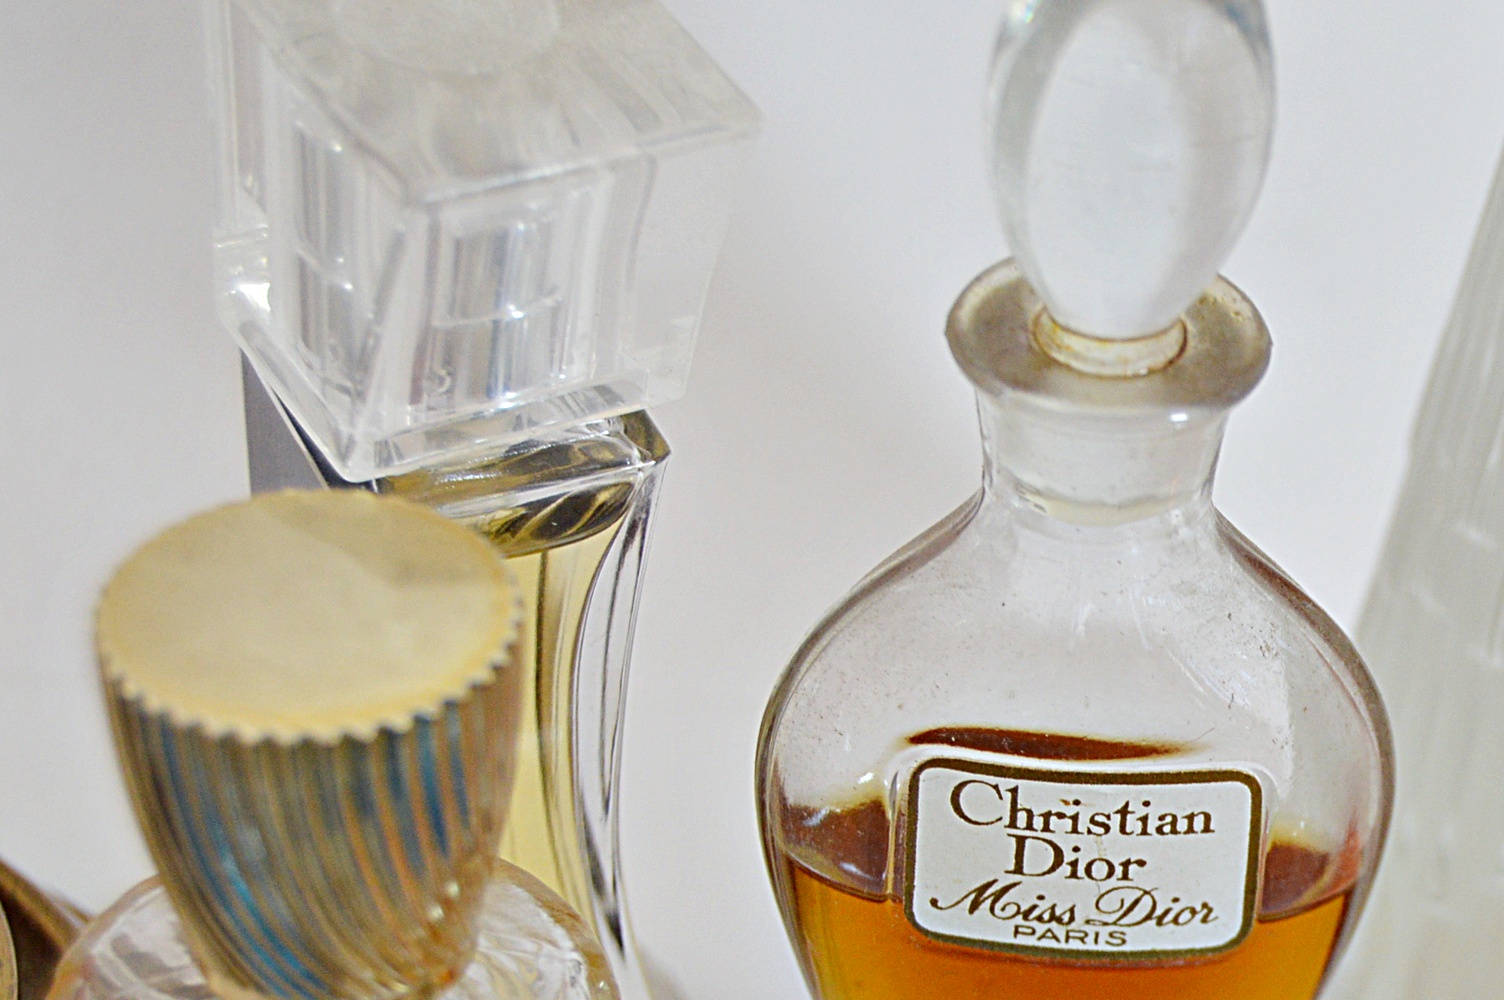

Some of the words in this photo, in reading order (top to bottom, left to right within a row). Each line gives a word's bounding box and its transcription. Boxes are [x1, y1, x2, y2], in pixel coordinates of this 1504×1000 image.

[949, 779, 1216, 836] Christian
[1004, 833, 1147, 881] Dior
[929, 878, 1076, 926] Miss
[1084, 885, 1219, 928] Dior
[1013, 924, 1127, 946] PARIS
